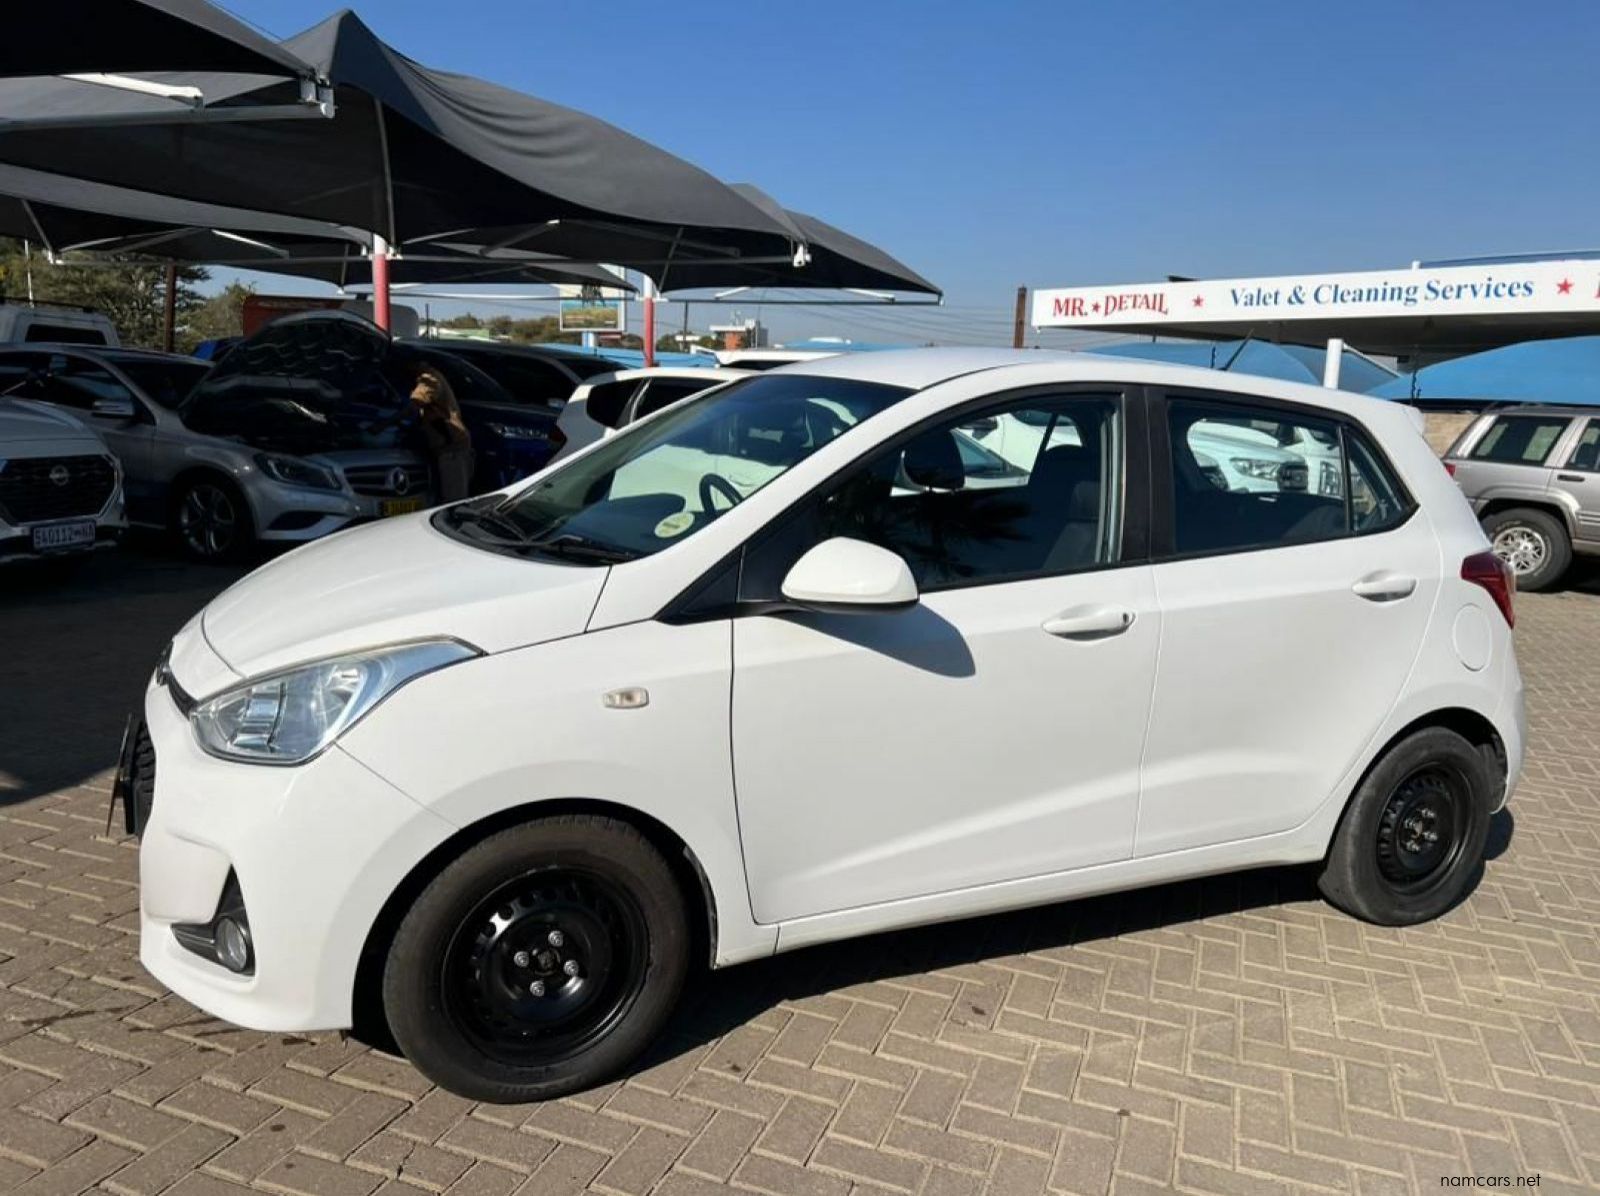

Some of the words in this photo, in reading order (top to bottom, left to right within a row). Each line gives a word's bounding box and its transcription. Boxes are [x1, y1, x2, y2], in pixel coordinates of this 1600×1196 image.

[1053, 297, 1088, 317] MR.
[1104, 292, 1168, 316] DETAIL
[1231, 287, 1280, 307] Valet
[1287, 285, 1305, 305] &
[1313, 281, 1419, 306] Cleaning
[1424, 277, 1535, 300] Services
